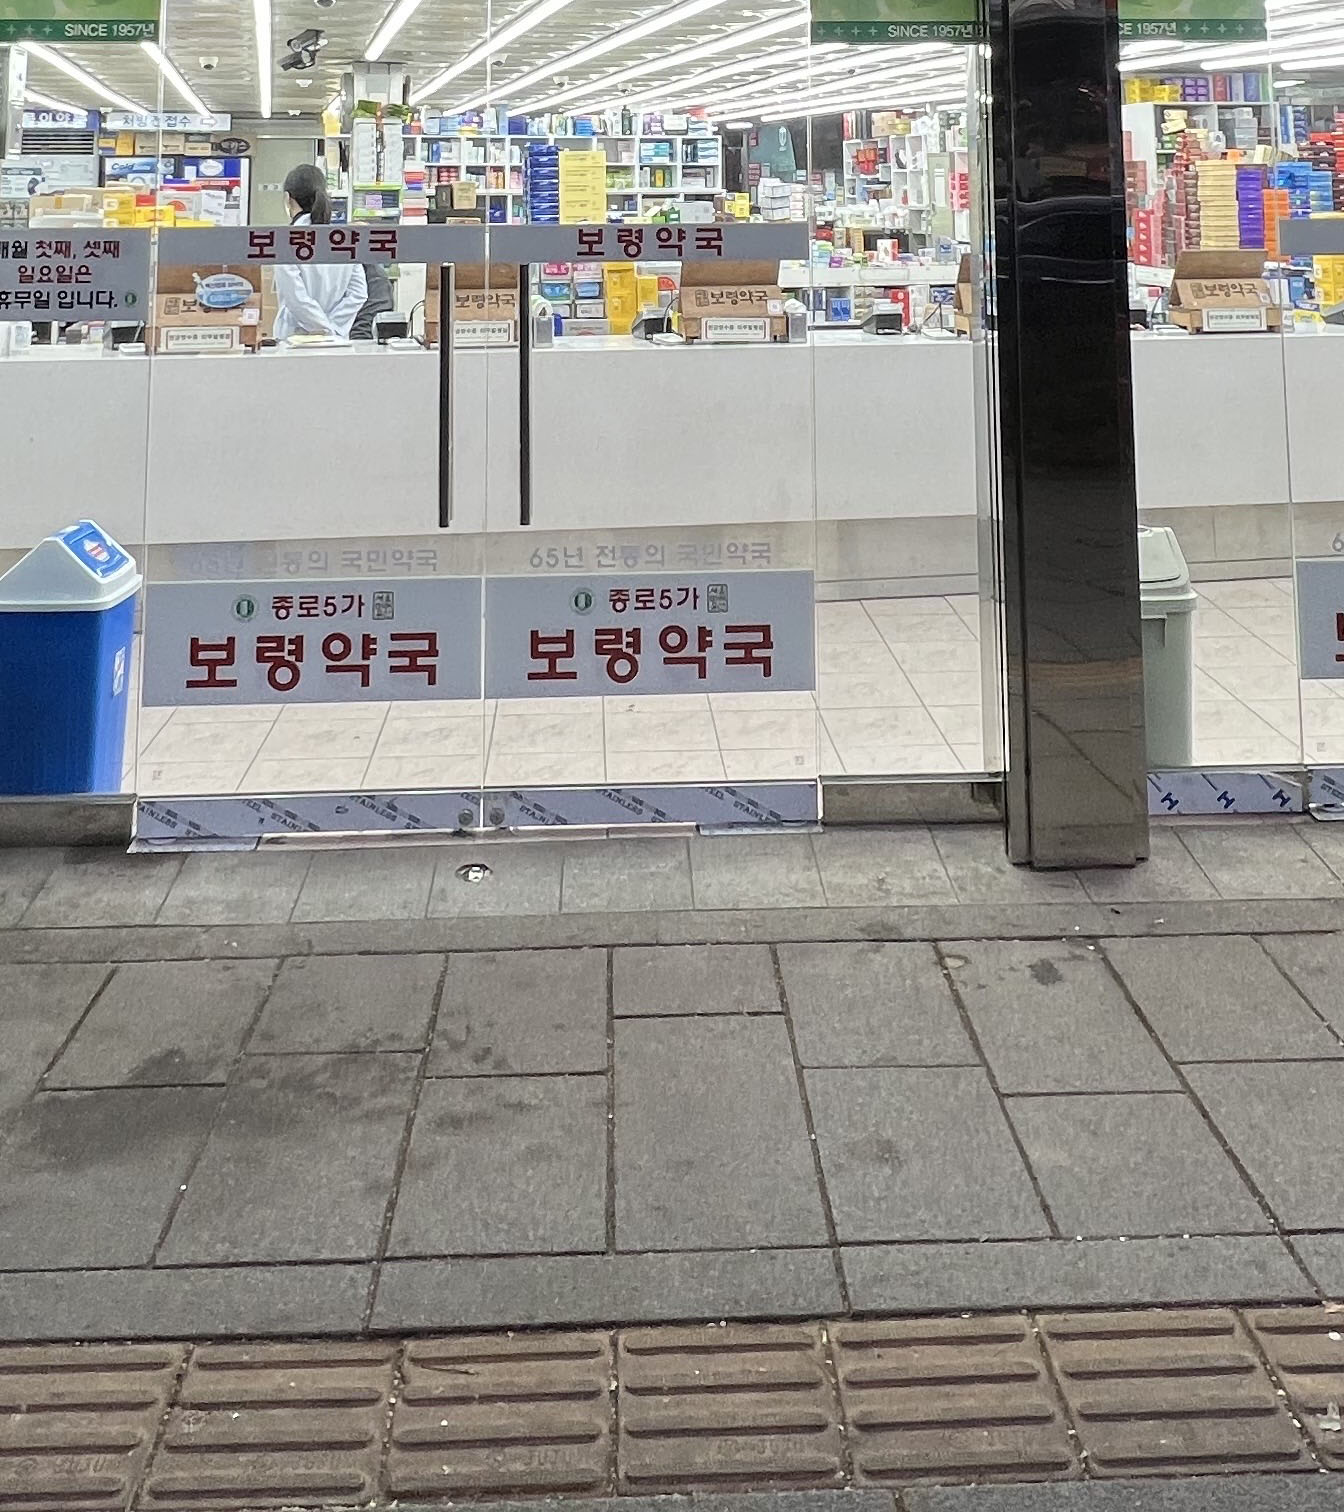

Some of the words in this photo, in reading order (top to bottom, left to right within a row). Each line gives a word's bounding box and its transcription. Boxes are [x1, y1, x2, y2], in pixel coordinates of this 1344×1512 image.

[64, 24, 108, 37] SINCE
[112, 23, 155, 38] 1957년
[887, 24, 929, 37] SINCE
[165, 115, 192, 128] 접수
[35, 240, 77, 259] 첫째,
[84, 240, 120, 259] 셋째
[248, 229, 399, 261] 보령약국
[576, 227, 724, 258] 보령약국
[17, 265, 92, 284] 일요일은
[455, 292, 516, 309] 보령약국
[711, 289, 768, 306] 보령약국
[1203, 282, 1258, 298] 보령약국
[340, 548, 438, 572] 국민약국
[529, 546, 584, 569] 65년
[596, 544, 665, 568] 전통의
[676, 541, 772, 567] 국민약국
[271, 594, 365, 620] 종로5가
[608, 587, 699, 613] 종로5가
[185, 631, 440, 692] 보령약국
[527, 623, 774, 684] 보령약국
